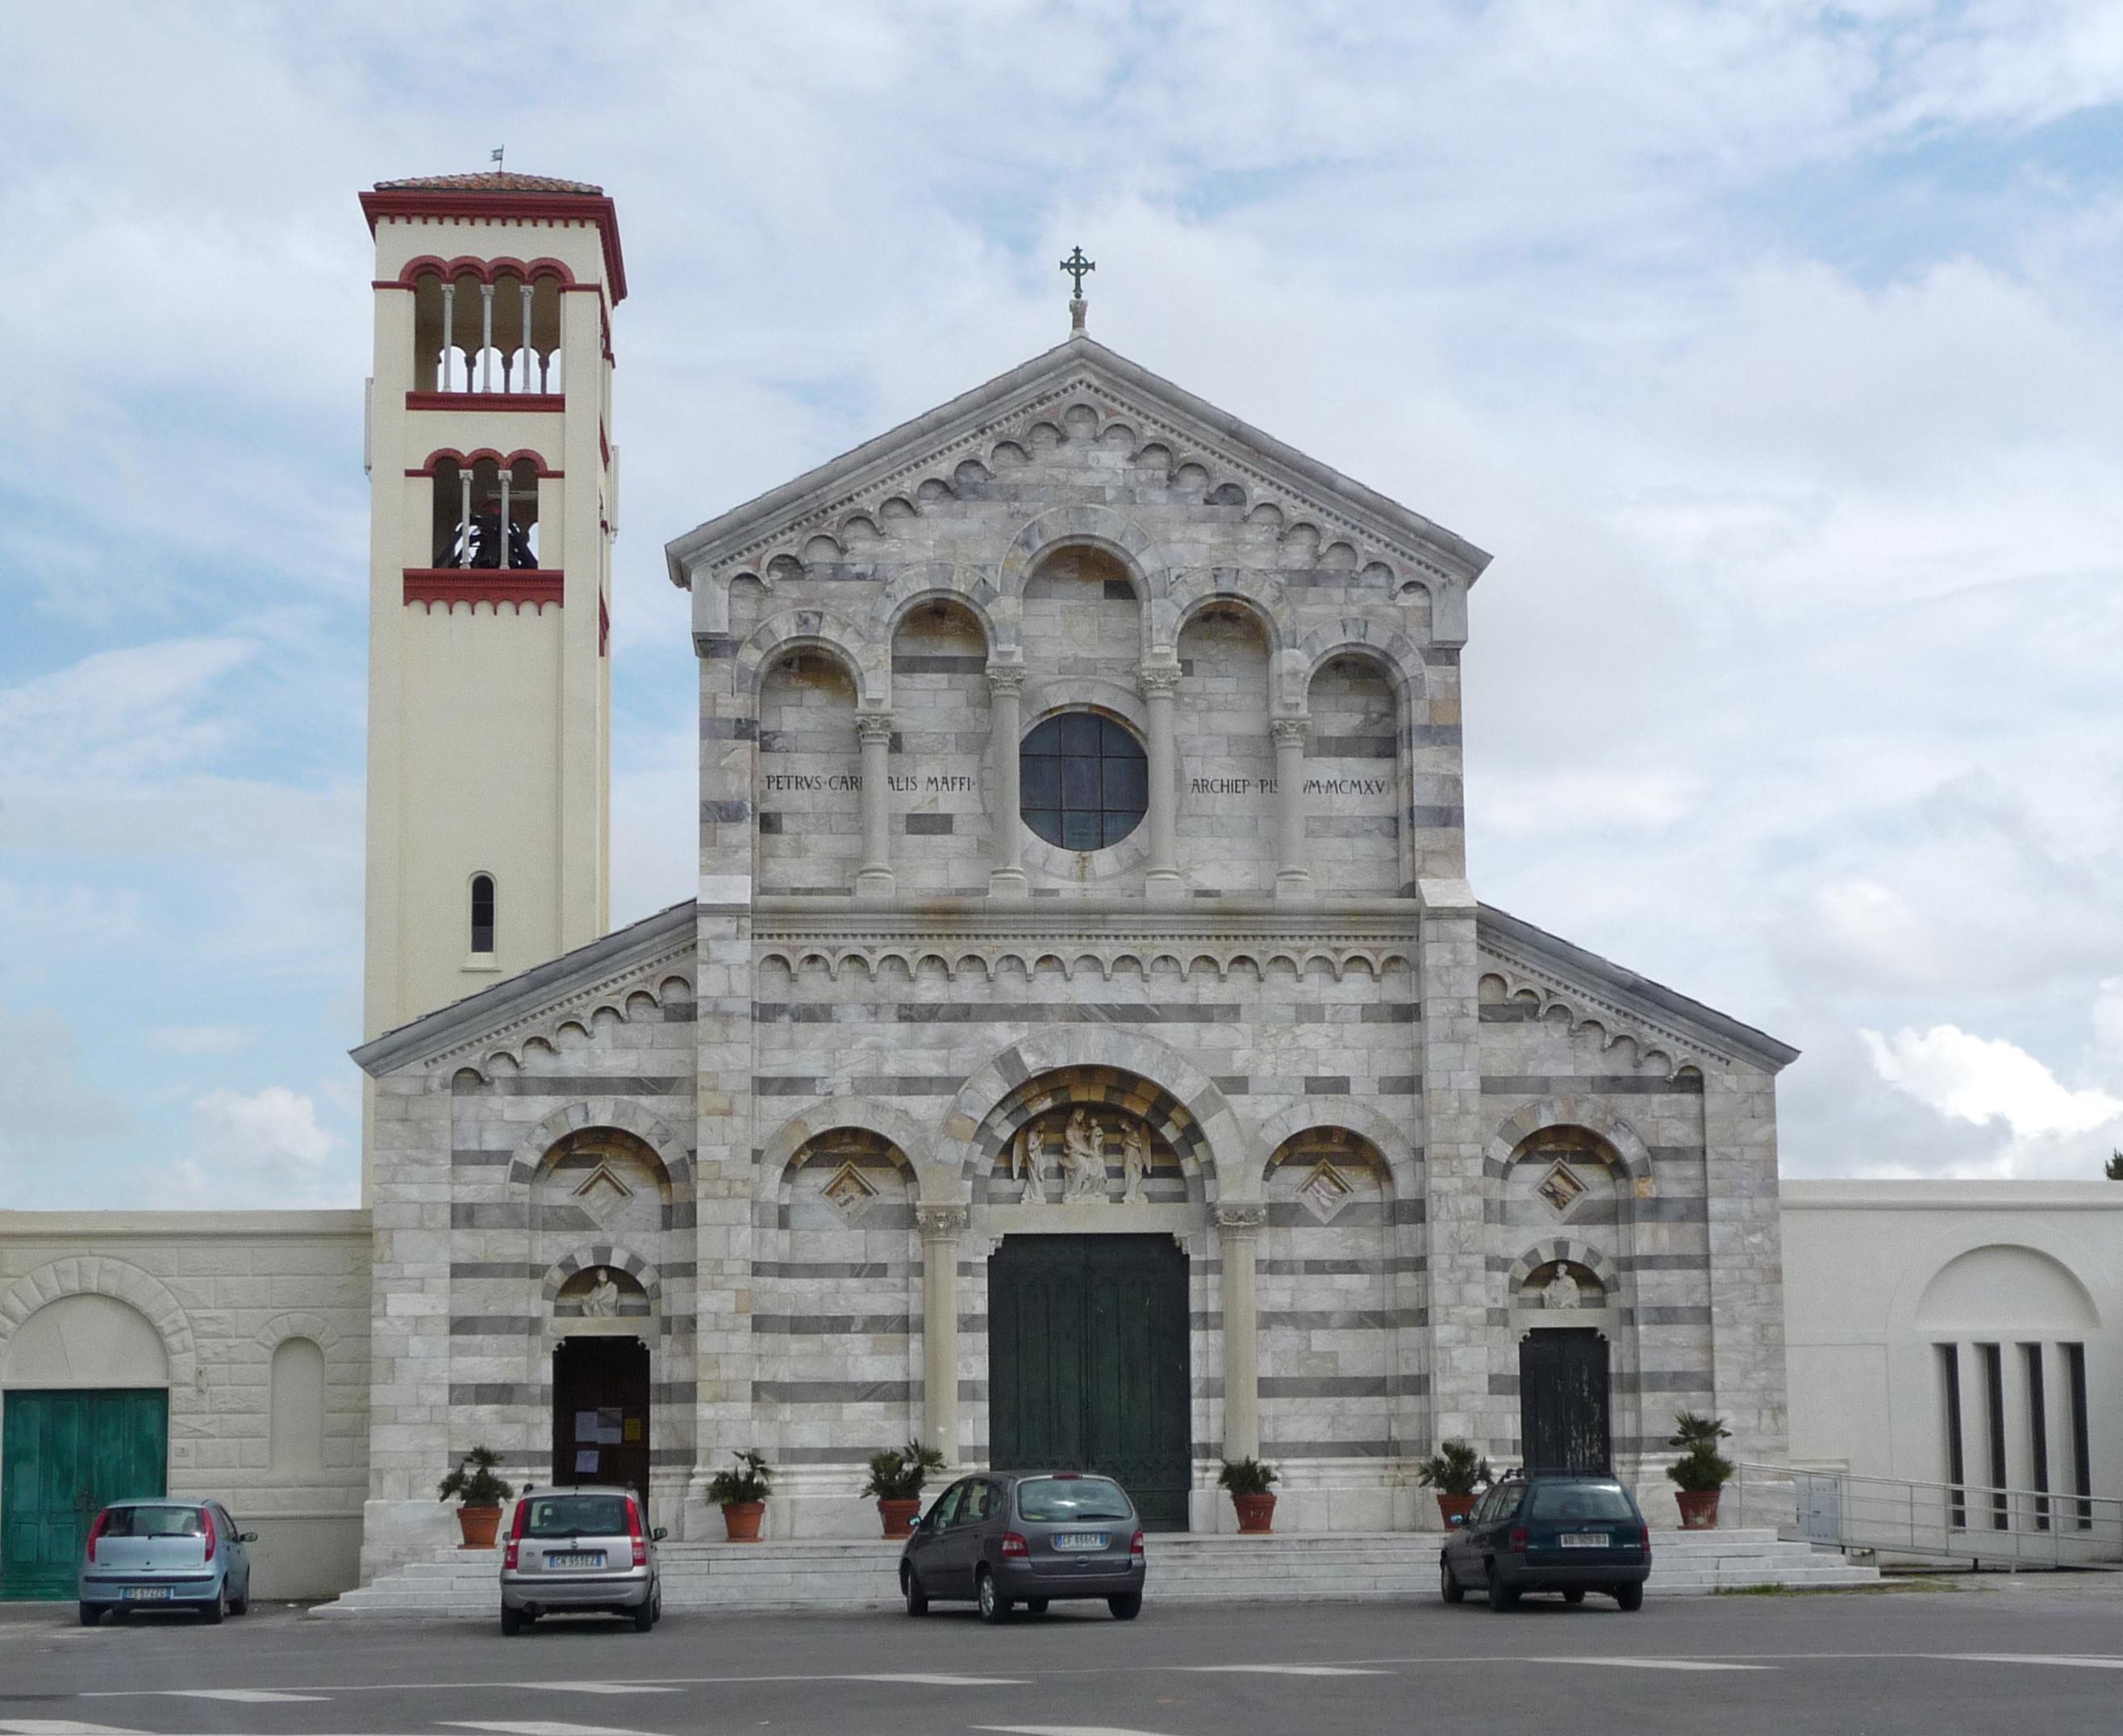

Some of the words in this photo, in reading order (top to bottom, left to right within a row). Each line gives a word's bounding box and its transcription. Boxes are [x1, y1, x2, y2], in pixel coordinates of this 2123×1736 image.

[766, 775, 822, 791] PETRVS
[926, 776, 970, 791] MAFFI
[1191, 778, 1250, 794] ARCHIEP
